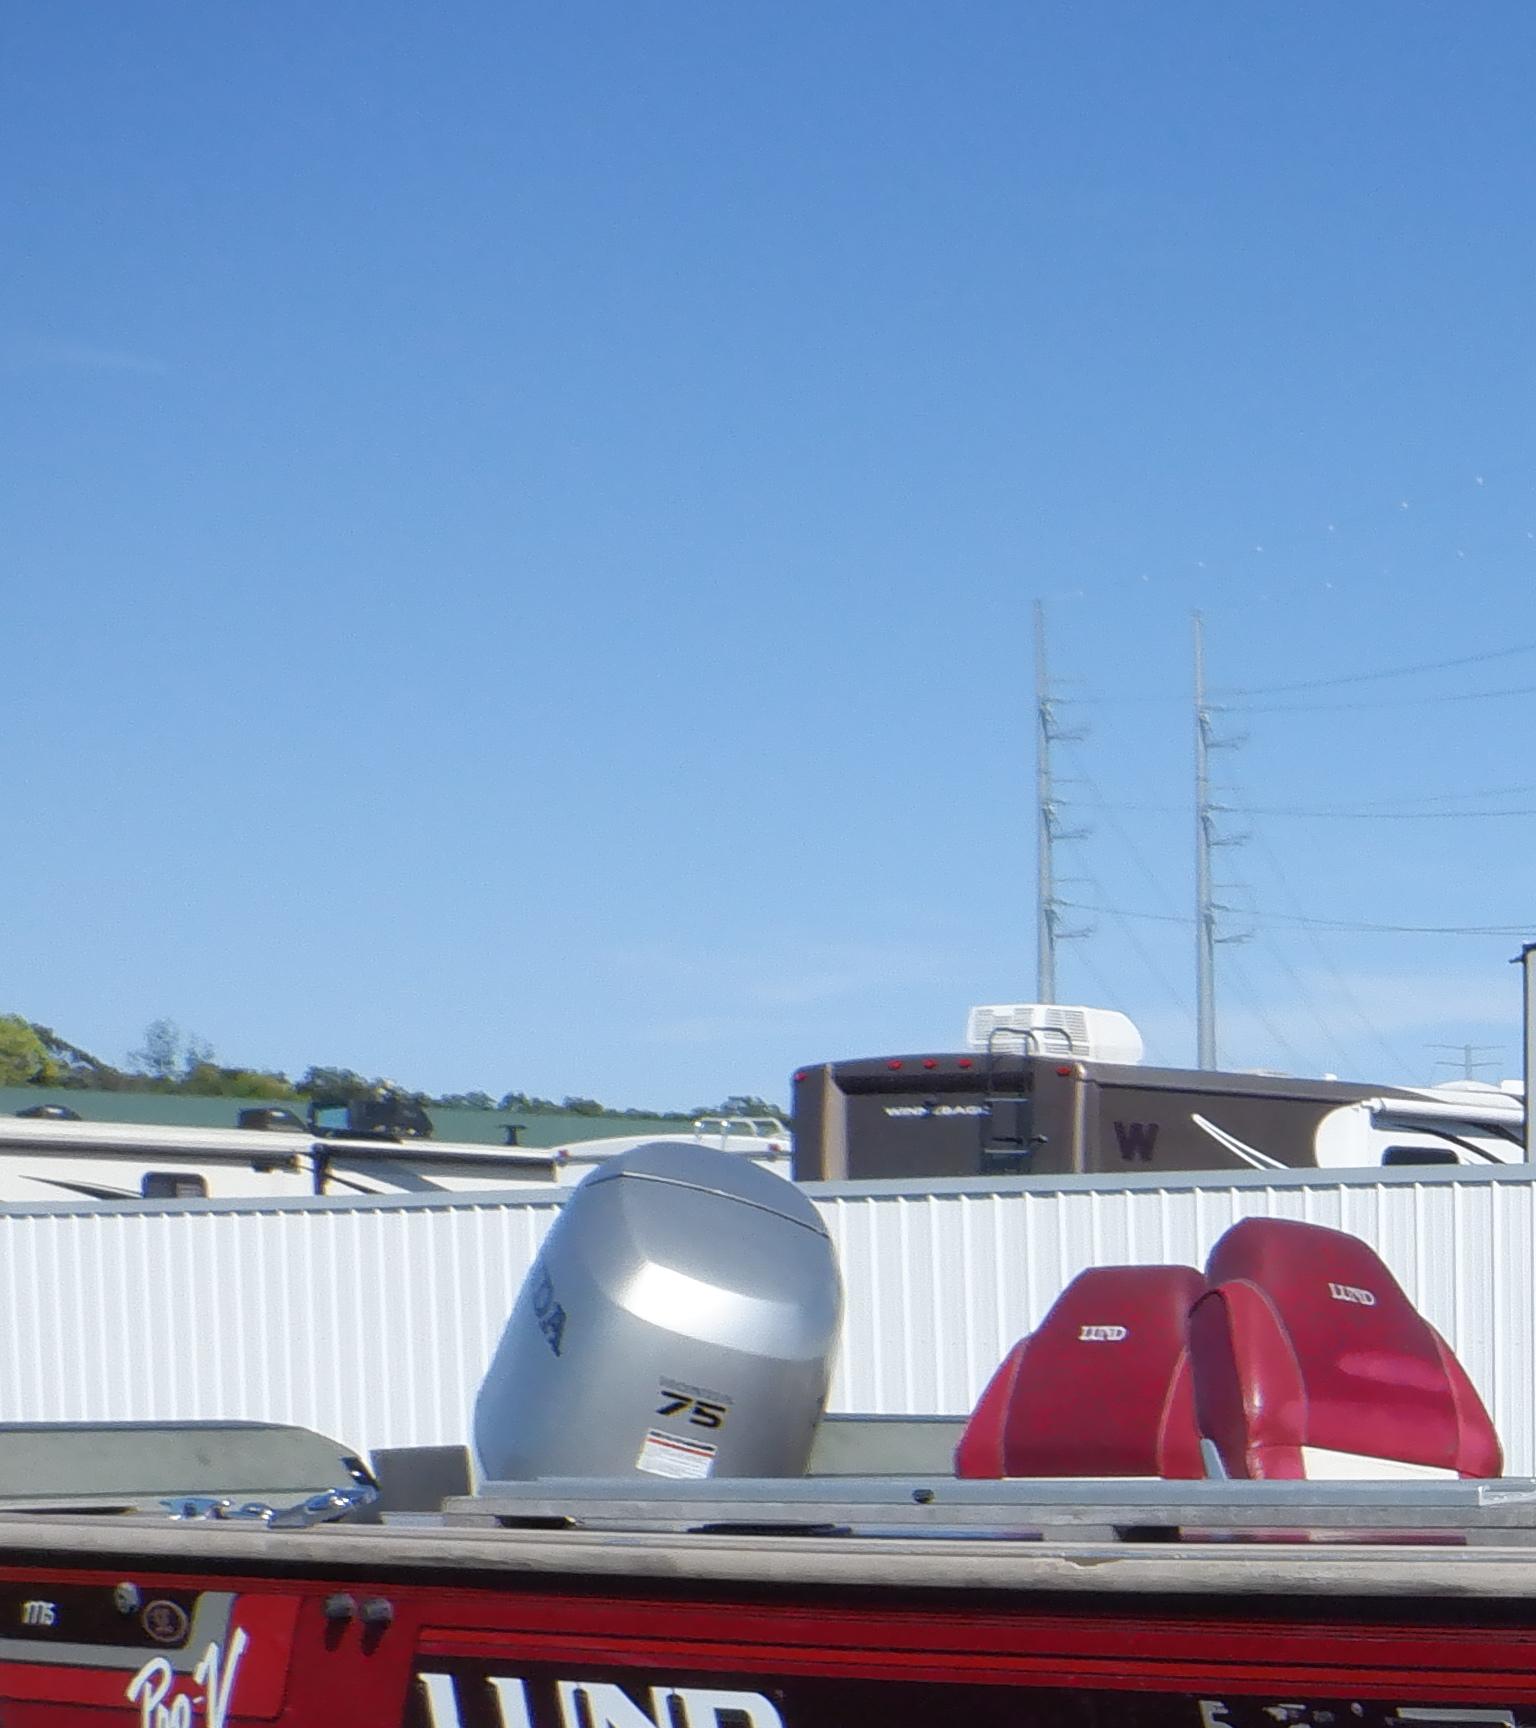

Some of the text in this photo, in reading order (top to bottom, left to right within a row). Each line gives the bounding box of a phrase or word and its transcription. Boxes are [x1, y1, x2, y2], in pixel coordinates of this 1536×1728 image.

[1114, 1121, 1159, 1162] W
[1328, 1282, 1375, 1306] LUND
[1078, 1325, 1127, 1341] LUND
[656, 1389, 728, 1429] 75
